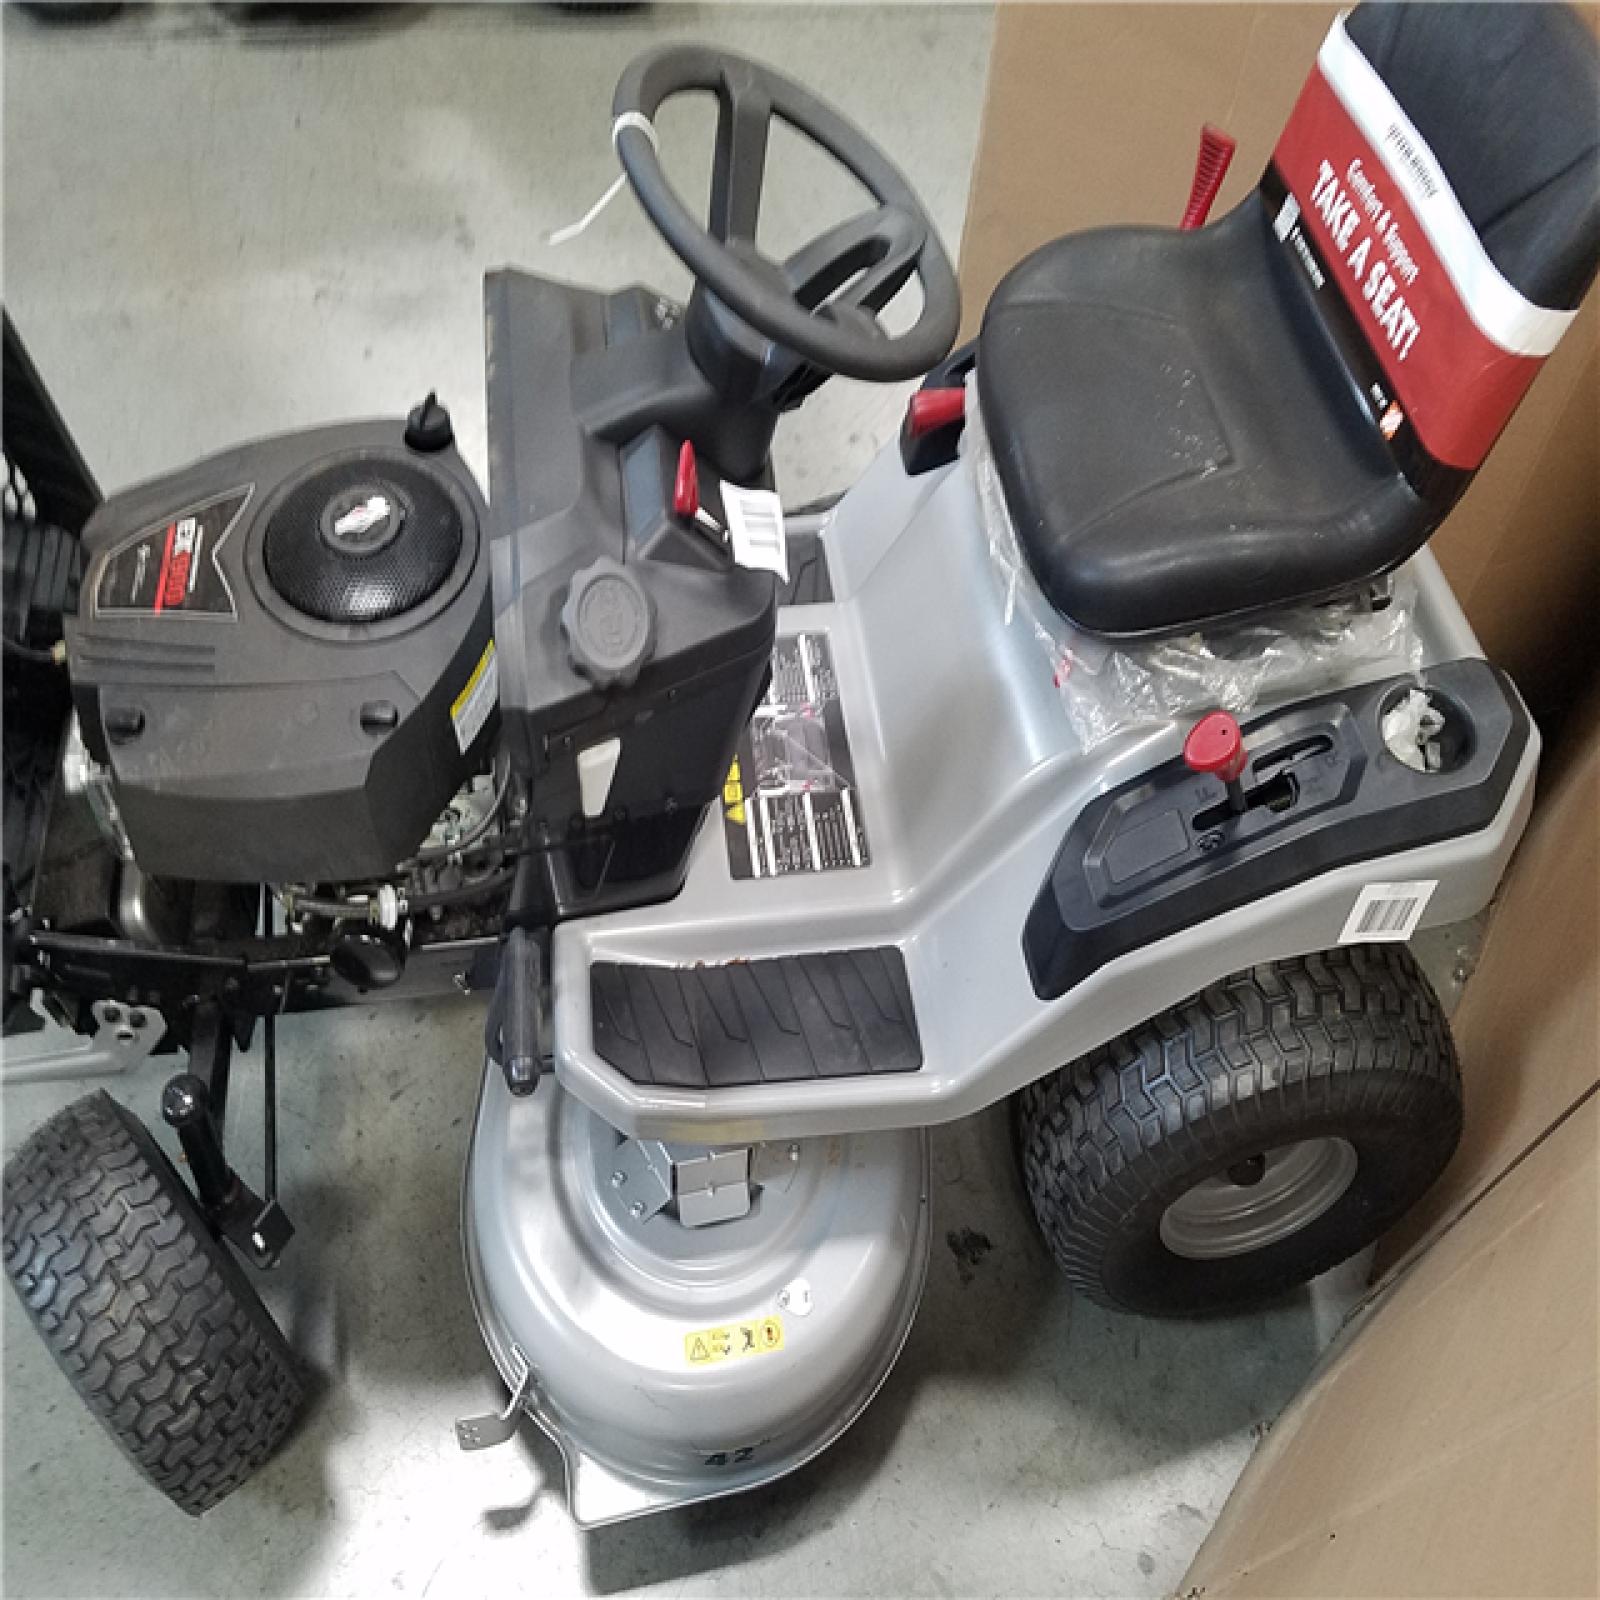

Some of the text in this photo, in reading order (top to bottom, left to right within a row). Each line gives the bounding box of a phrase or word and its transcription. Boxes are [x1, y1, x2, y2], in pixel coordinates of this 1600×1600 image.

[1311, 159, 1361, 252] TAKE
[1347, 237, 1372, 281] A
[1362, 261, 1421, 361] SEAT!
